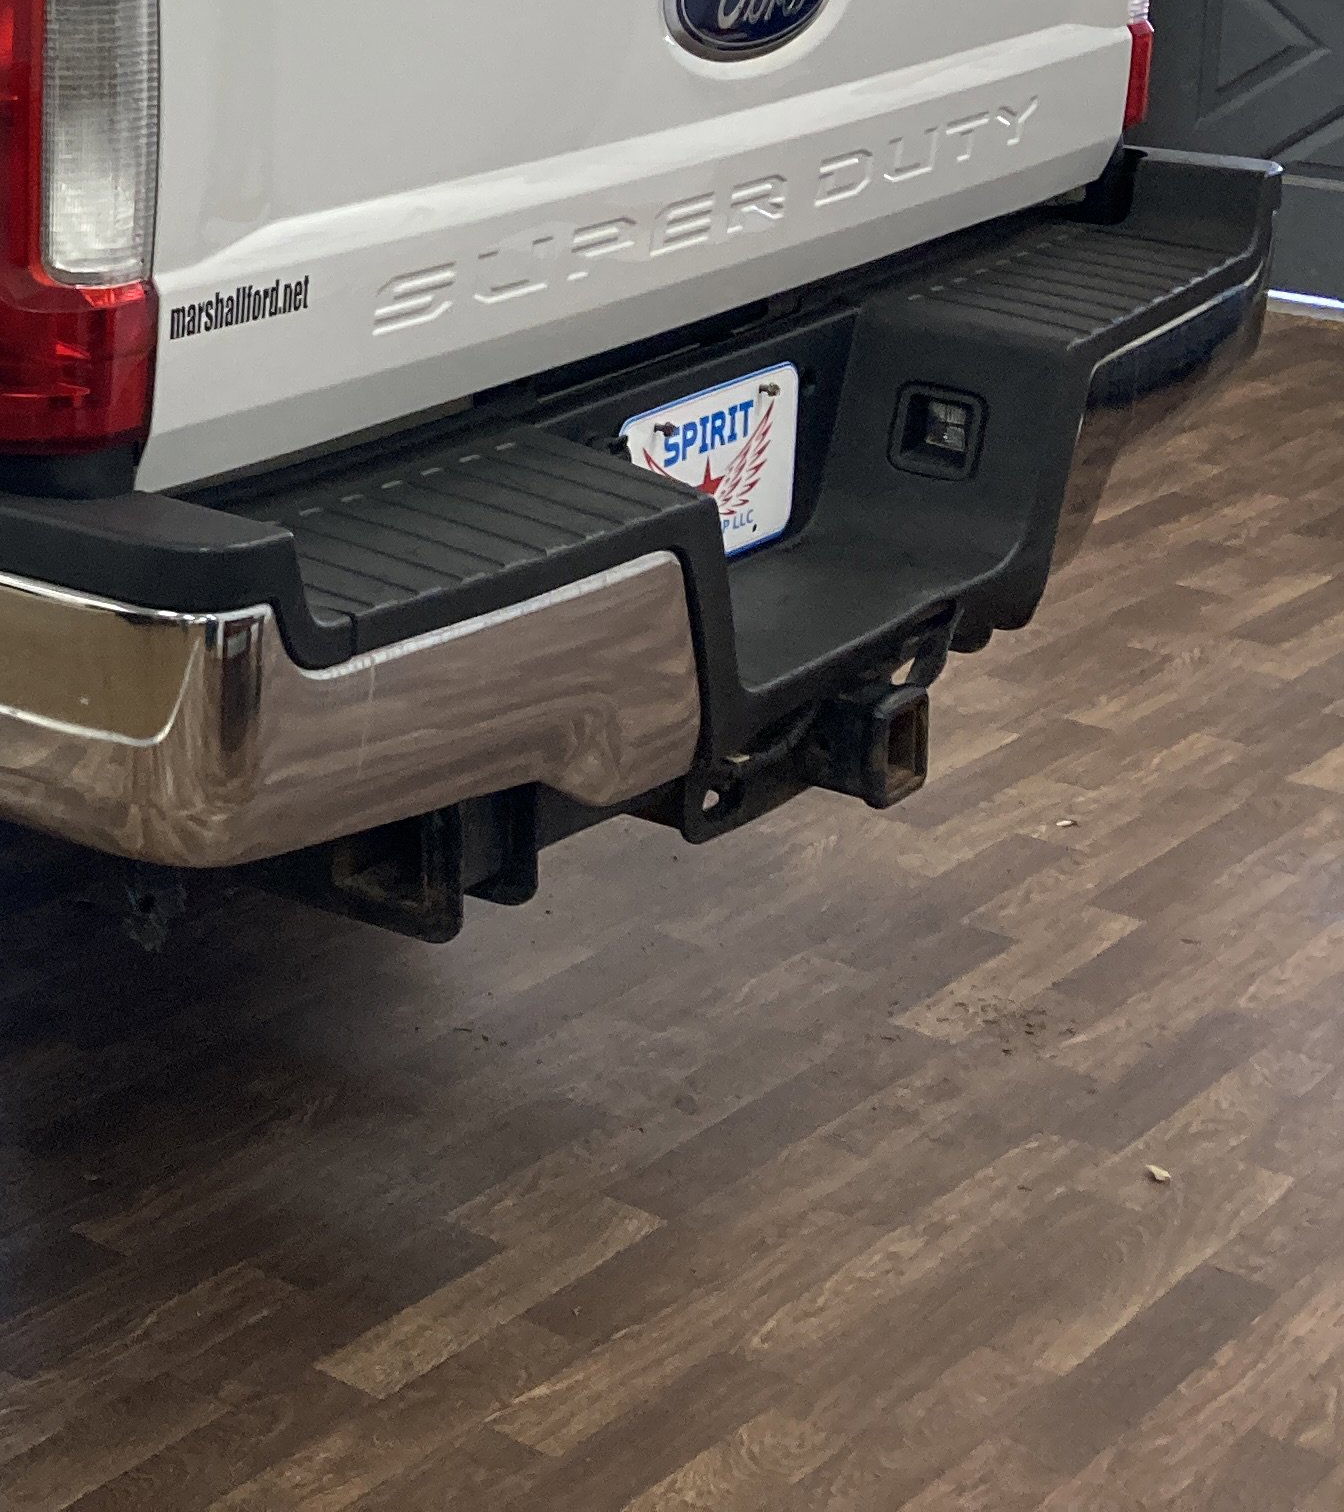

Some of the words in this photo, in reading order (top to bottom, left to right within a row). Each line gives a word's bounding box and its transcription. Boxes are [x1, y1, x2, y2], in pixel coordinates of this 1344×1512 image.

[372, 173, 787, 337] SUPER
[813, 95, 1042, 209] DUTY
[169, 274, 310, 340] marshallford.net
[663, 399, 754, 468] SPIRIT
[732, 509, 754, 530] LLC
